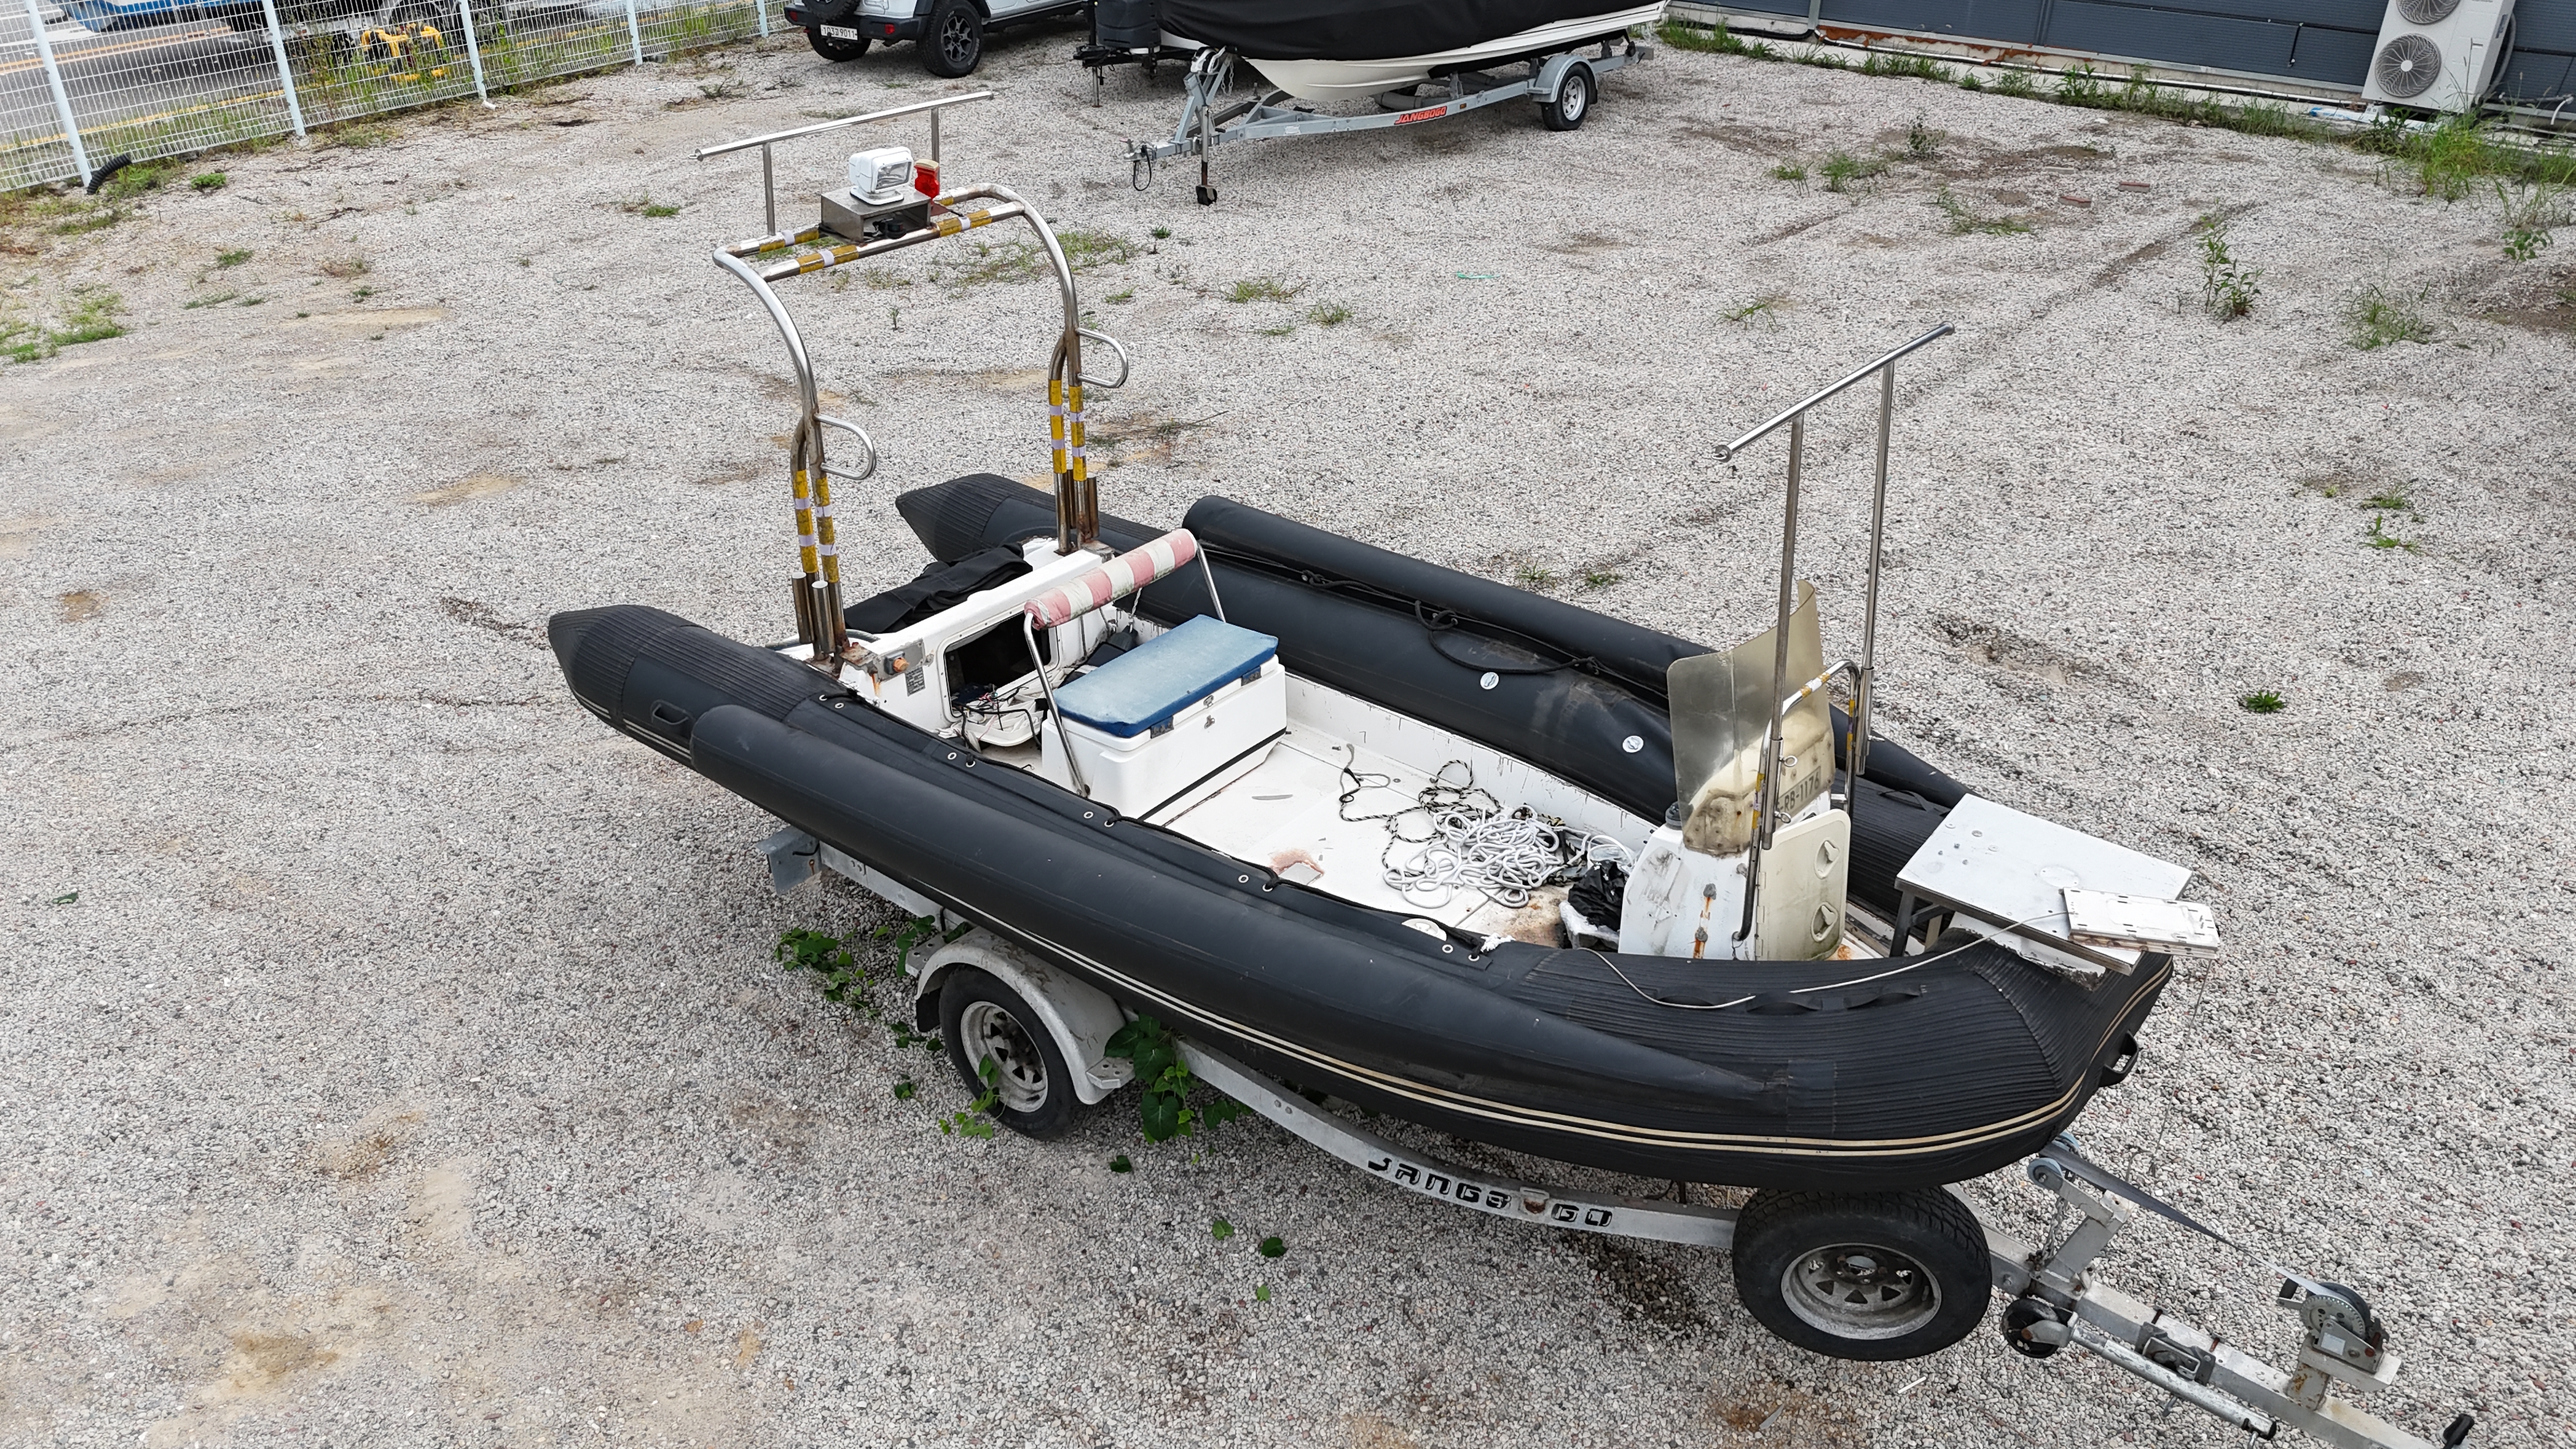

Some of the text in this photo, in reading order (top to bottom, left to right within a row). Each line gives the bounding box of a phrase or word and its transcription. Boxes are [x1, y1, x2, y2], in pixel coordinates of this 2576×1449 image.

[839, 28, 855, 38] 9011
[1394, 105, 1447, 125] JANGBOGO
[1777, 771, 1820, 812] -RB-1176
[1368, 1157, 1613, 1227] JANGBGO
